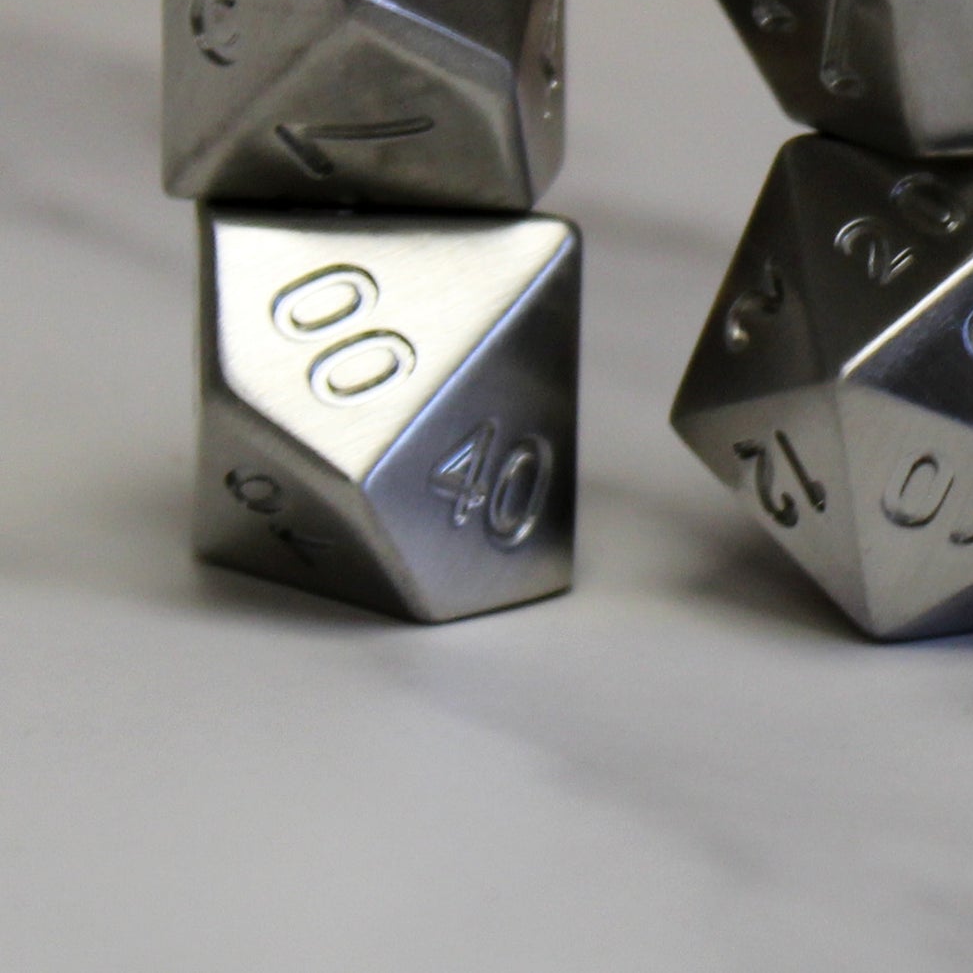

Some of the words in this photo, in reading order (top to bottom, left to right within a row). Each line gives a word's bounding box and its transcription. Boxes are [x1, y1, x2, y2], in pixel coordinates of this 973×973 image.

[834, 171, 967, 288] 20
[270, 262, 418, 408] 00
[427, 417, 554, 552] 40
[731, 428, 828, 529] 12
